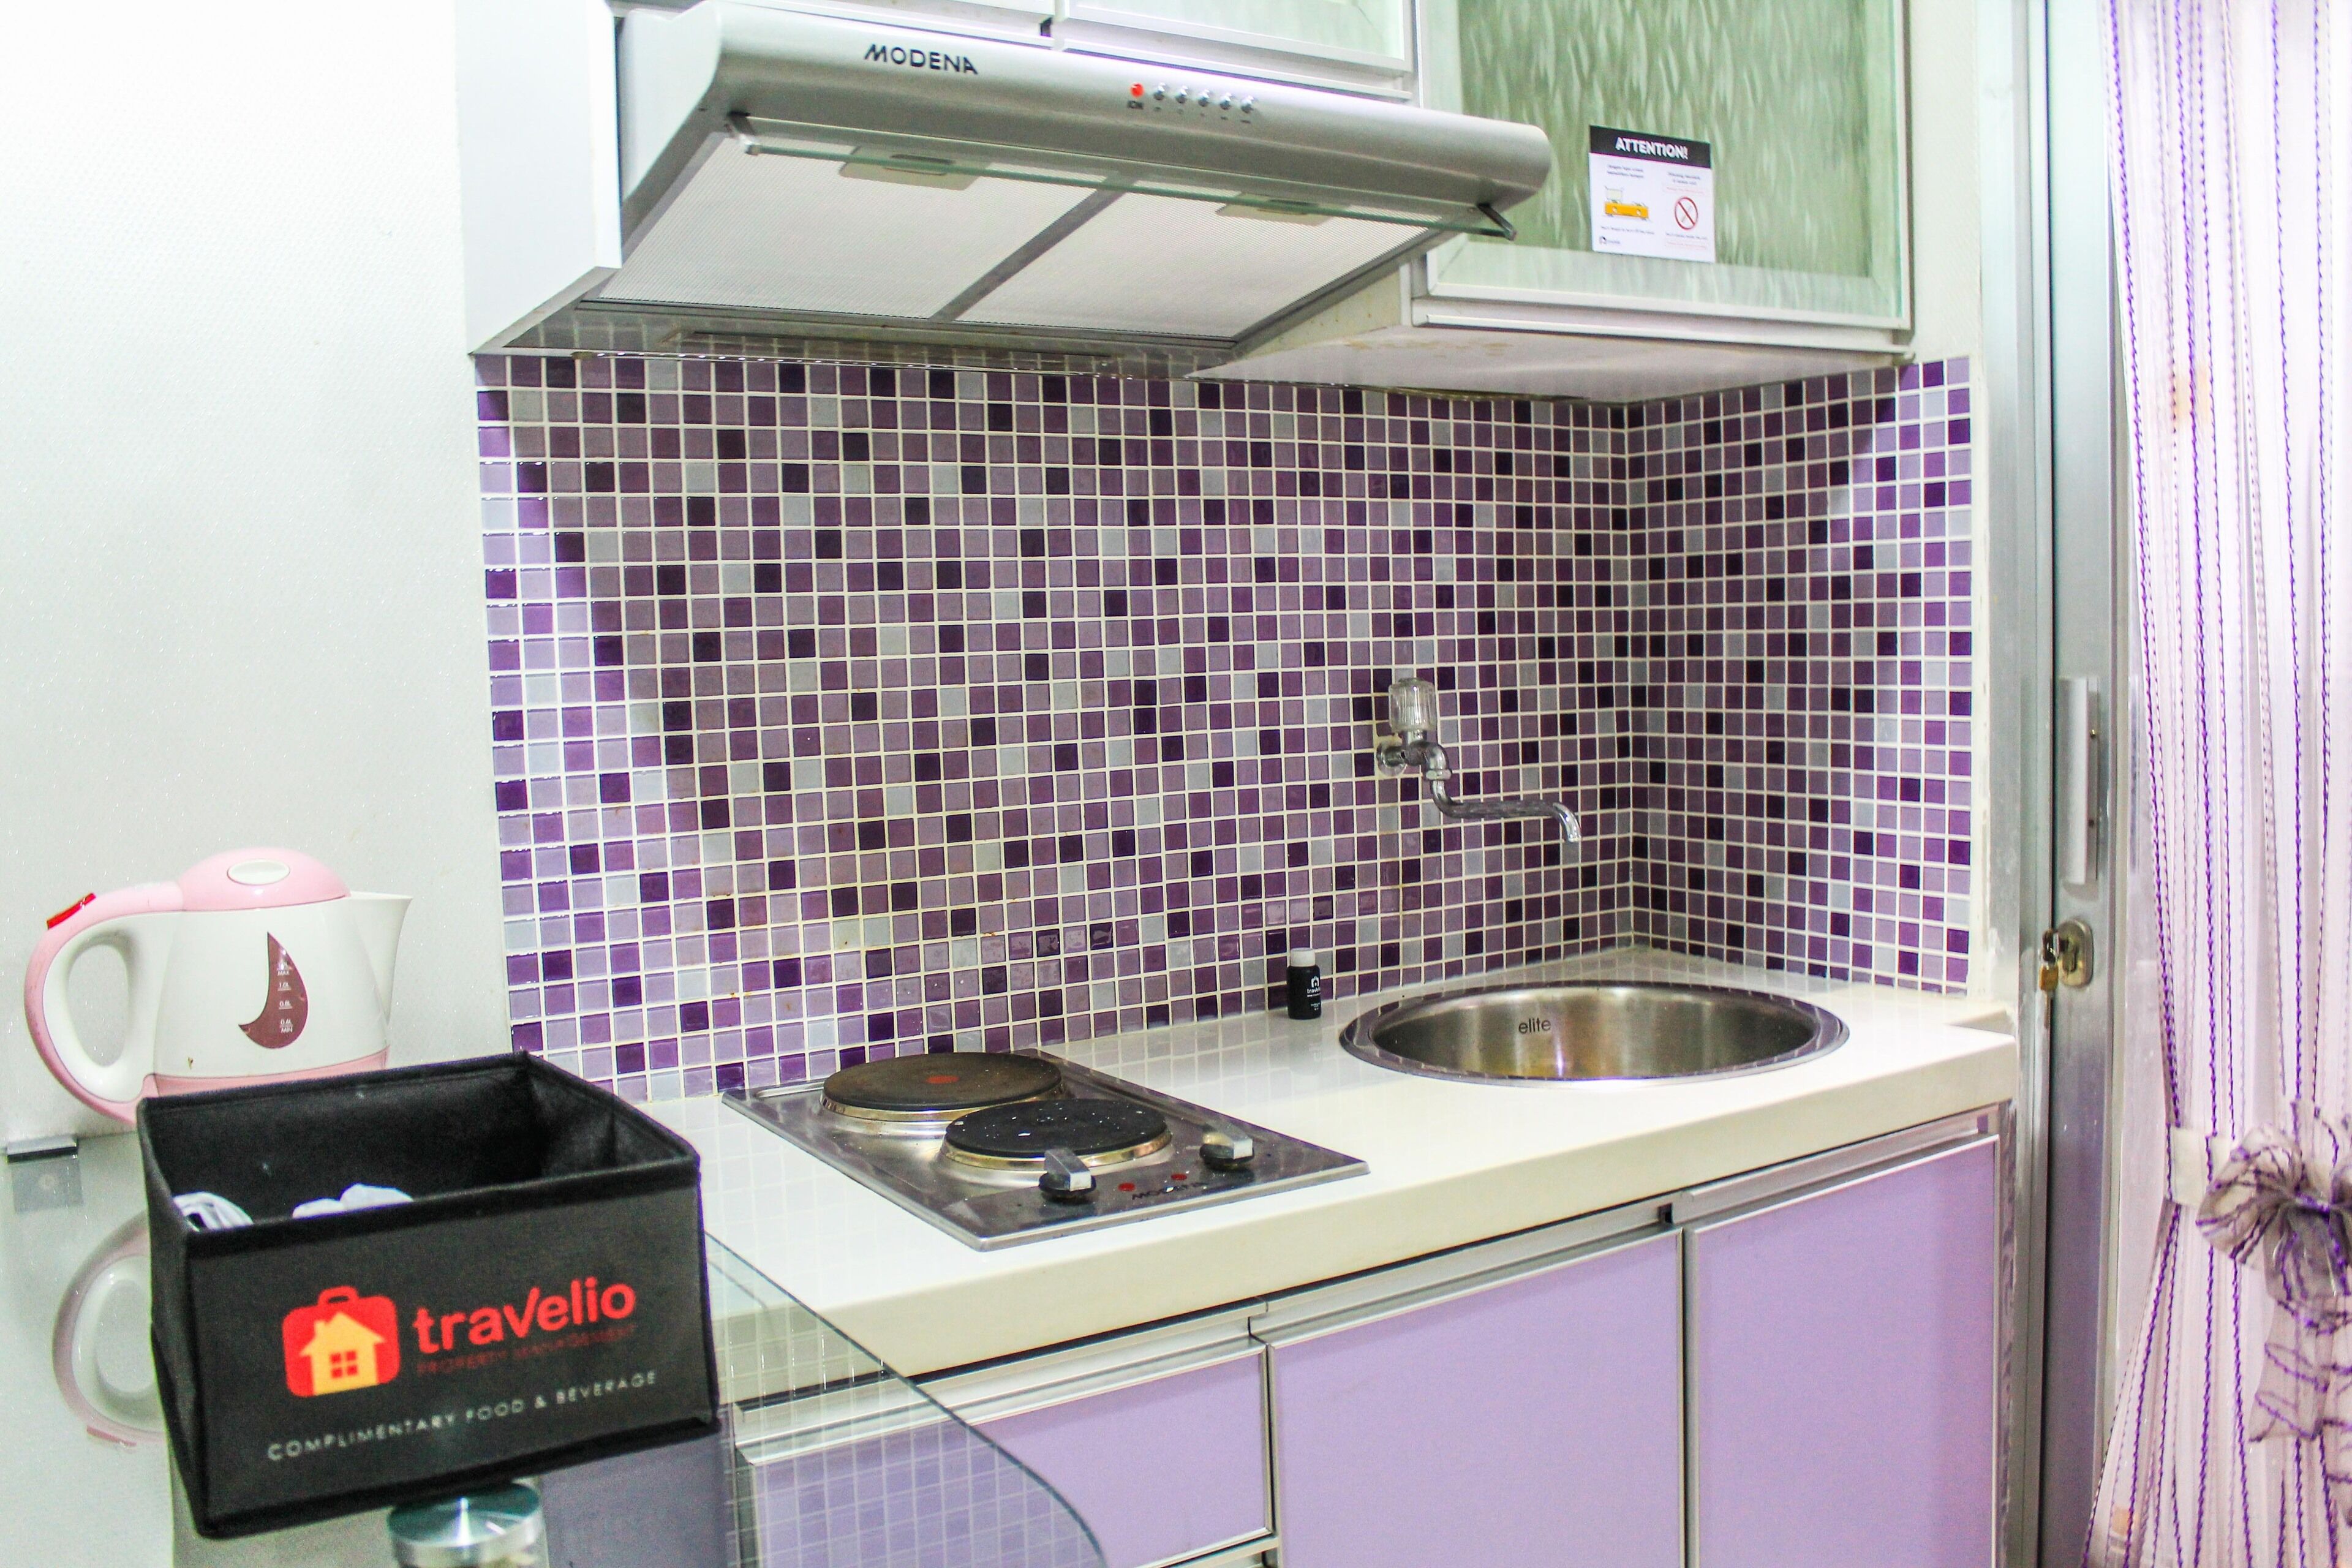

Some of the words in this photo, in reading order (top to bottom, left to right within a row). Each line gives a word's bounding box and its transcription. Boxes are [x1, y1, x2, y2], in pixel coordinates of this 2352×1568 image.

[864, 43, 979, 75] MODENA
[1615, 137, 1689, 160] ATTENTION!
[1518, 1017, 1551, 1034] elite
[412, 1276, 636, 1355] travelio
[267, 1414, 455, 1462] COMPLIMENTARY
[466, 1398, 524, 1423] FOOD
[535, 1395, 547, 1409] &
[556, 1370, 656, 1404] BEVERAGE
